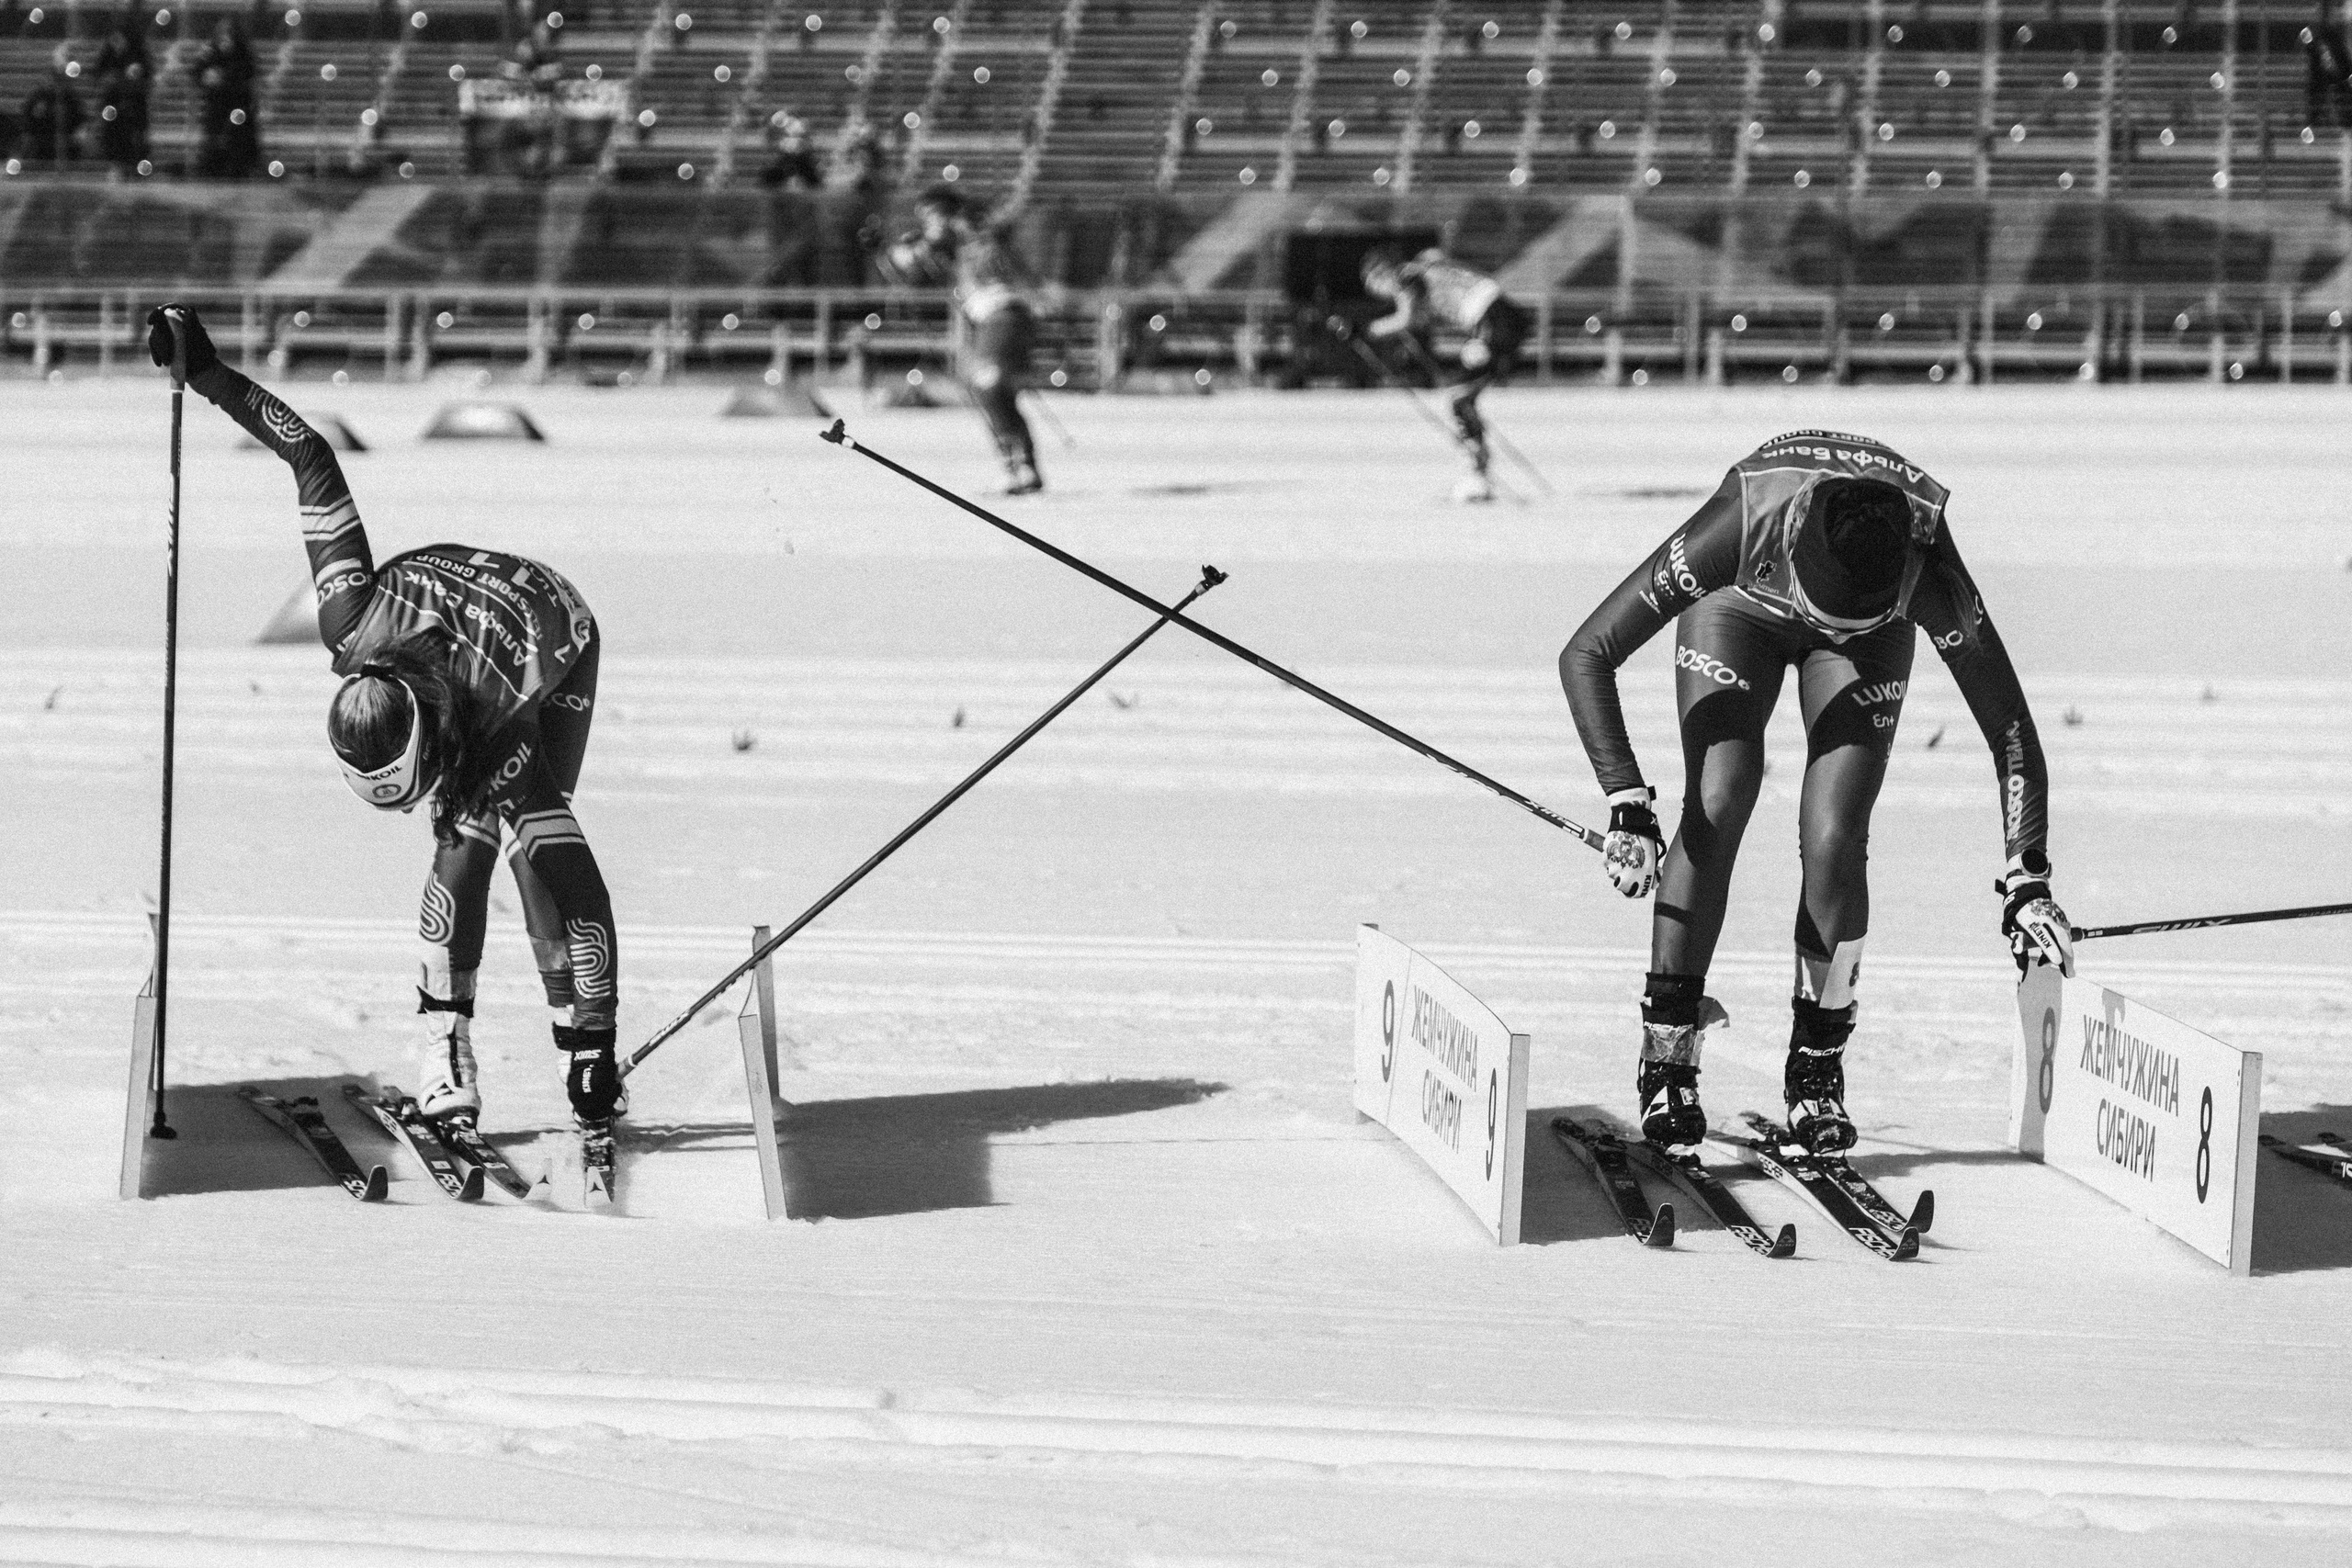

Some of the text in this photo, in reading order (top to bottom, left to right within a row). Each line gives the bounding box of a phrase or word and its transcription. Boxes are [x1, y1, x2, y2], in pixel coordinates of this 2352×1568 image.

[1762, 446, 1924, 484] Альфа Банк
[416, 554, 476, 579] GROUP
[1676, 646, 1737, 685] BOSCO
[573, 1049, 602, 1061] SWIX
[1381, 979, 1395, 1083] 9
[1411, 985, 1478, 1093] ЖЕМЧУЖИНА
[2039, 1007, 2056, 1115] 8
[2079, 1014, 2179, 1117] ЖЕМЧУЖИНА
[1422, 1068, 1463, 1155] СИБИРИ
[1486, 1067, 1497, 1182] 9
[2097, 1098, 2155, 1183] СИБИРИ
[2197, 1086, 2212, 1204] 8
